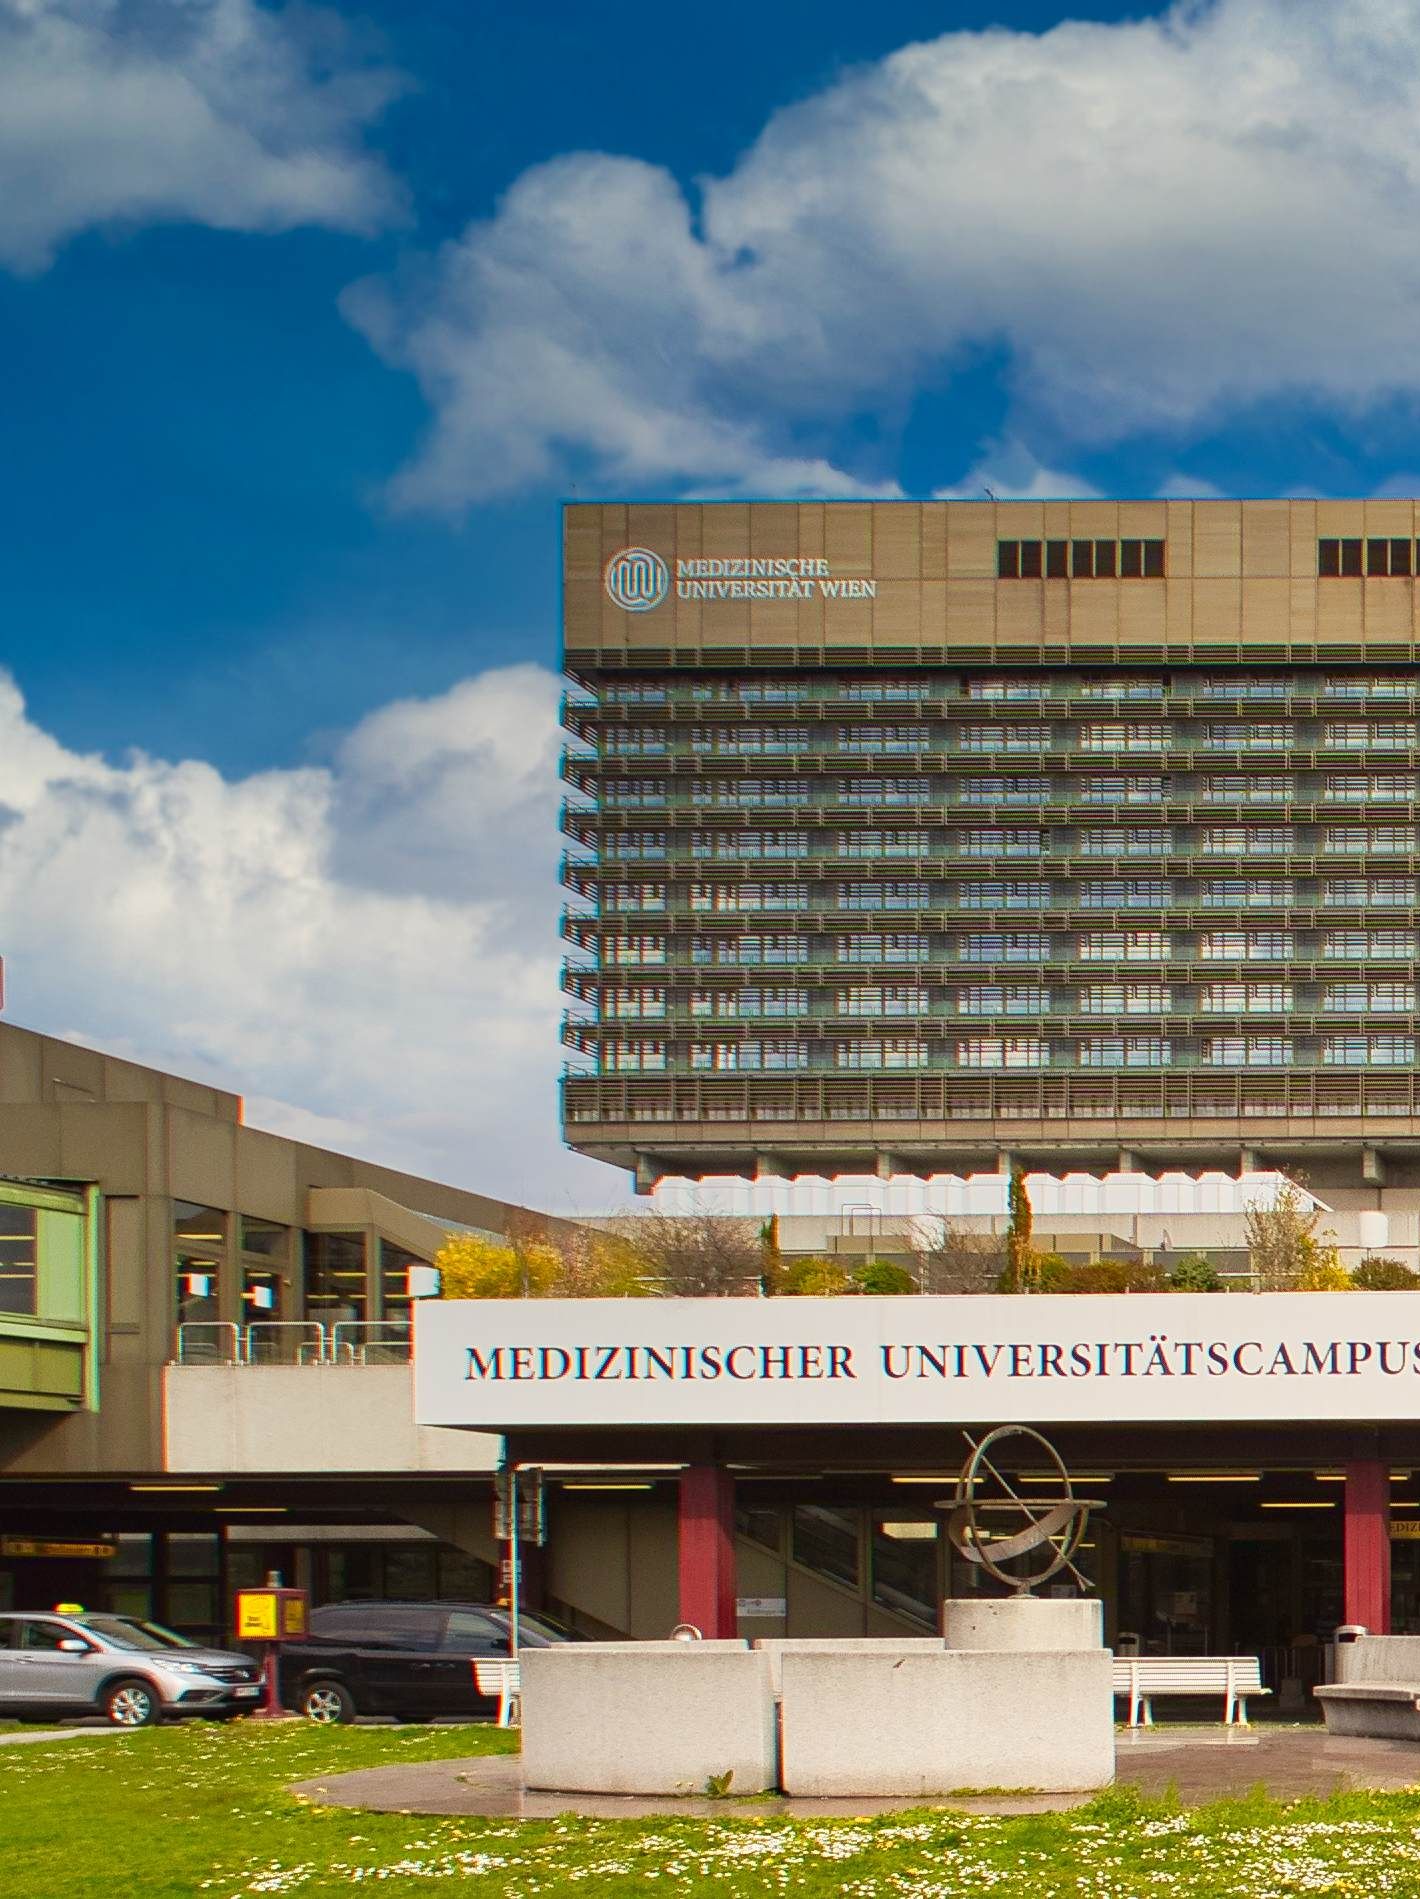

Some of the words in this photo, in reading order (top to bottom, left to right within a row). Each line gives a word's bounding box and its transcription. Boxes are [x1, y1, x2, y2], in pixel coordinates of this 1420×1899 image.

[677, 558, 830, 577] MEDIZINISCHE
[677, 578, 815, 599] UNIVERSITÄT
[819, 580, 877, 598] WIEN
[465, 1346, 857, 1380] MEDIZINISCHER
